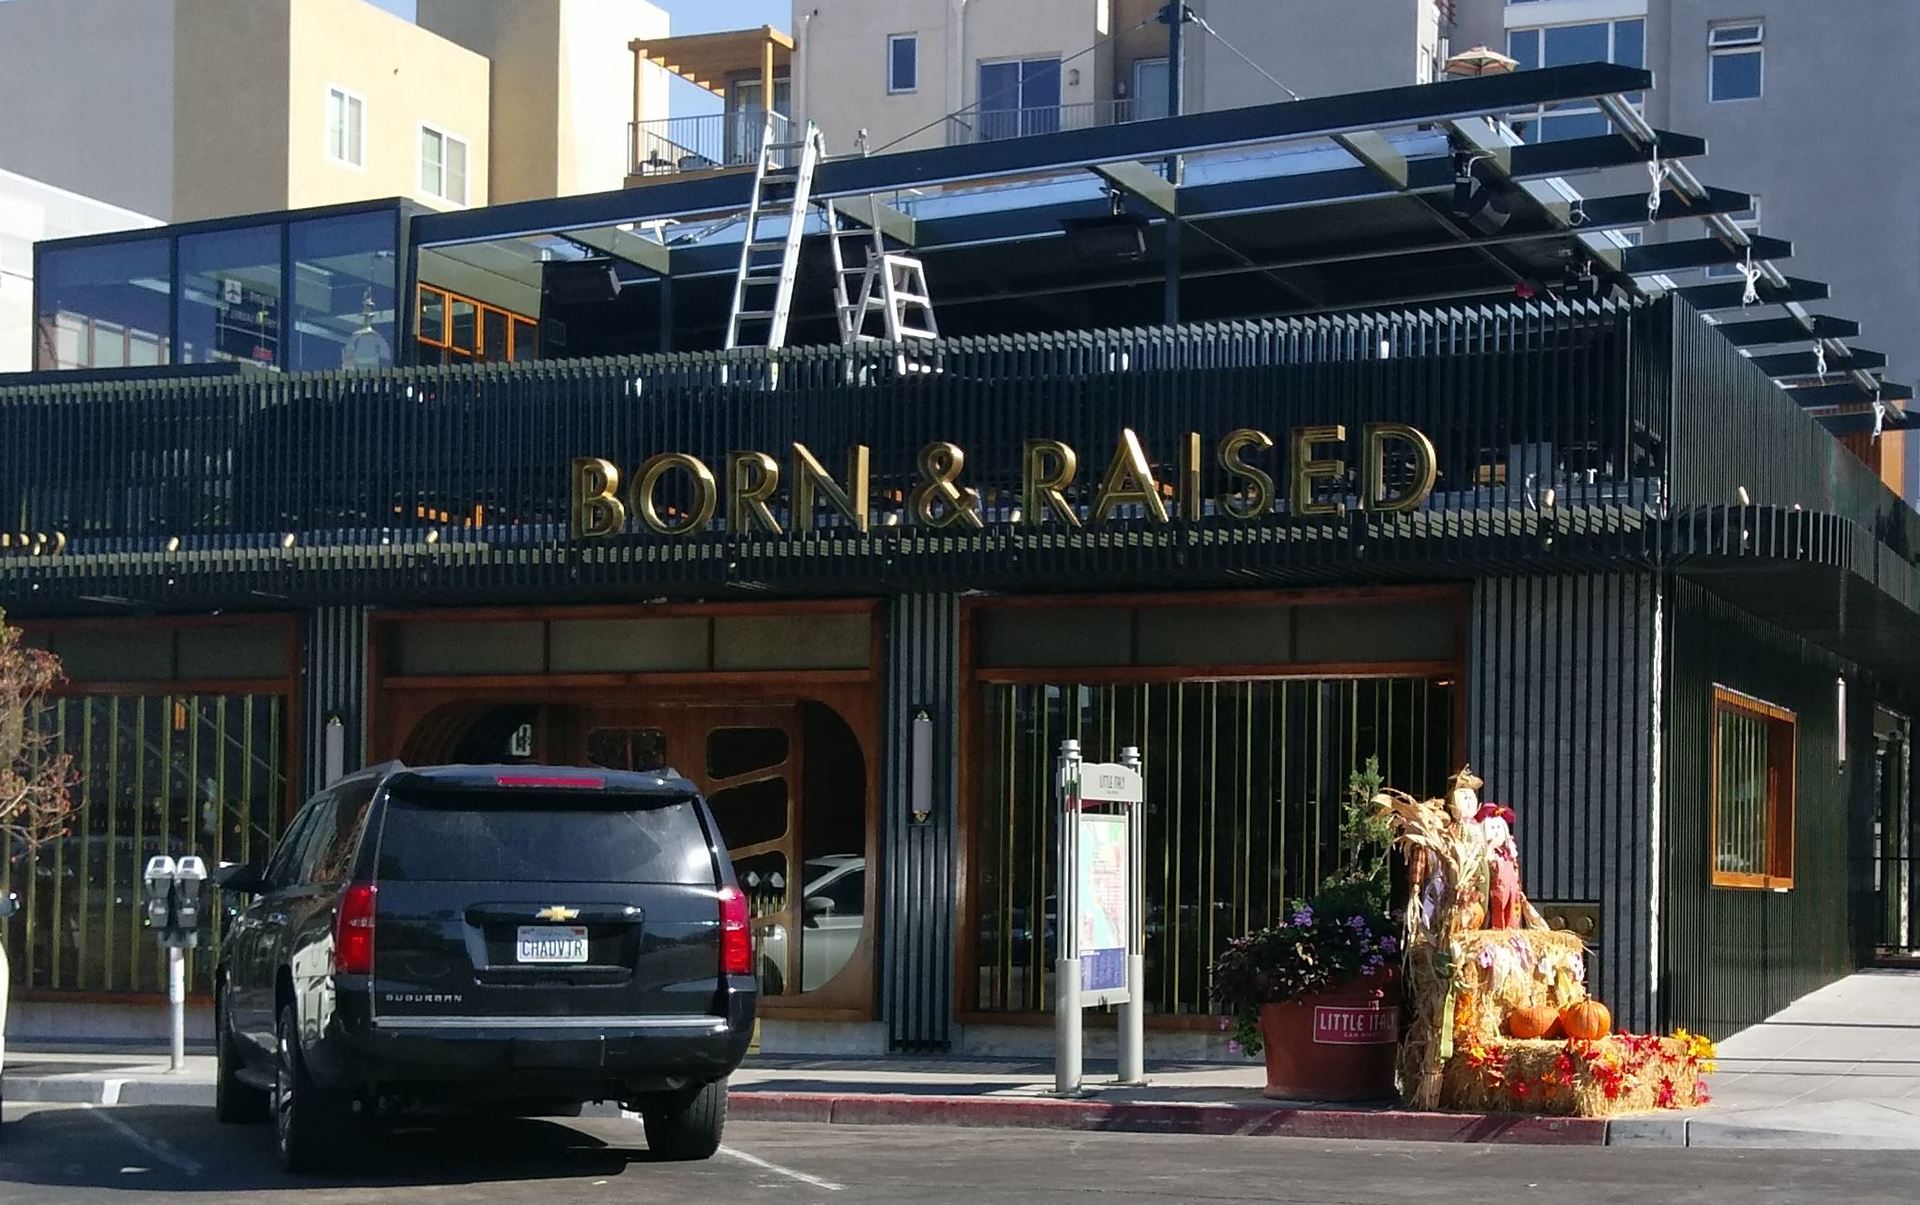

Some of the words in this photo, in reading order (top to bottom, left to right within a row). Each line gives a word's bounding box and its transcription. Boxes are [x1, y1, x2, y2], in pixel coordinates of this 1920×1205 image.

[572, 441, 870, 539] BORN
[910, 441, 984, 529] &
[1022, 423, 1437, 527] RAISED
[385, 993, 462, 1003] SUBURBAN
[1319, 1012, 1365, 1032] LITTLE
